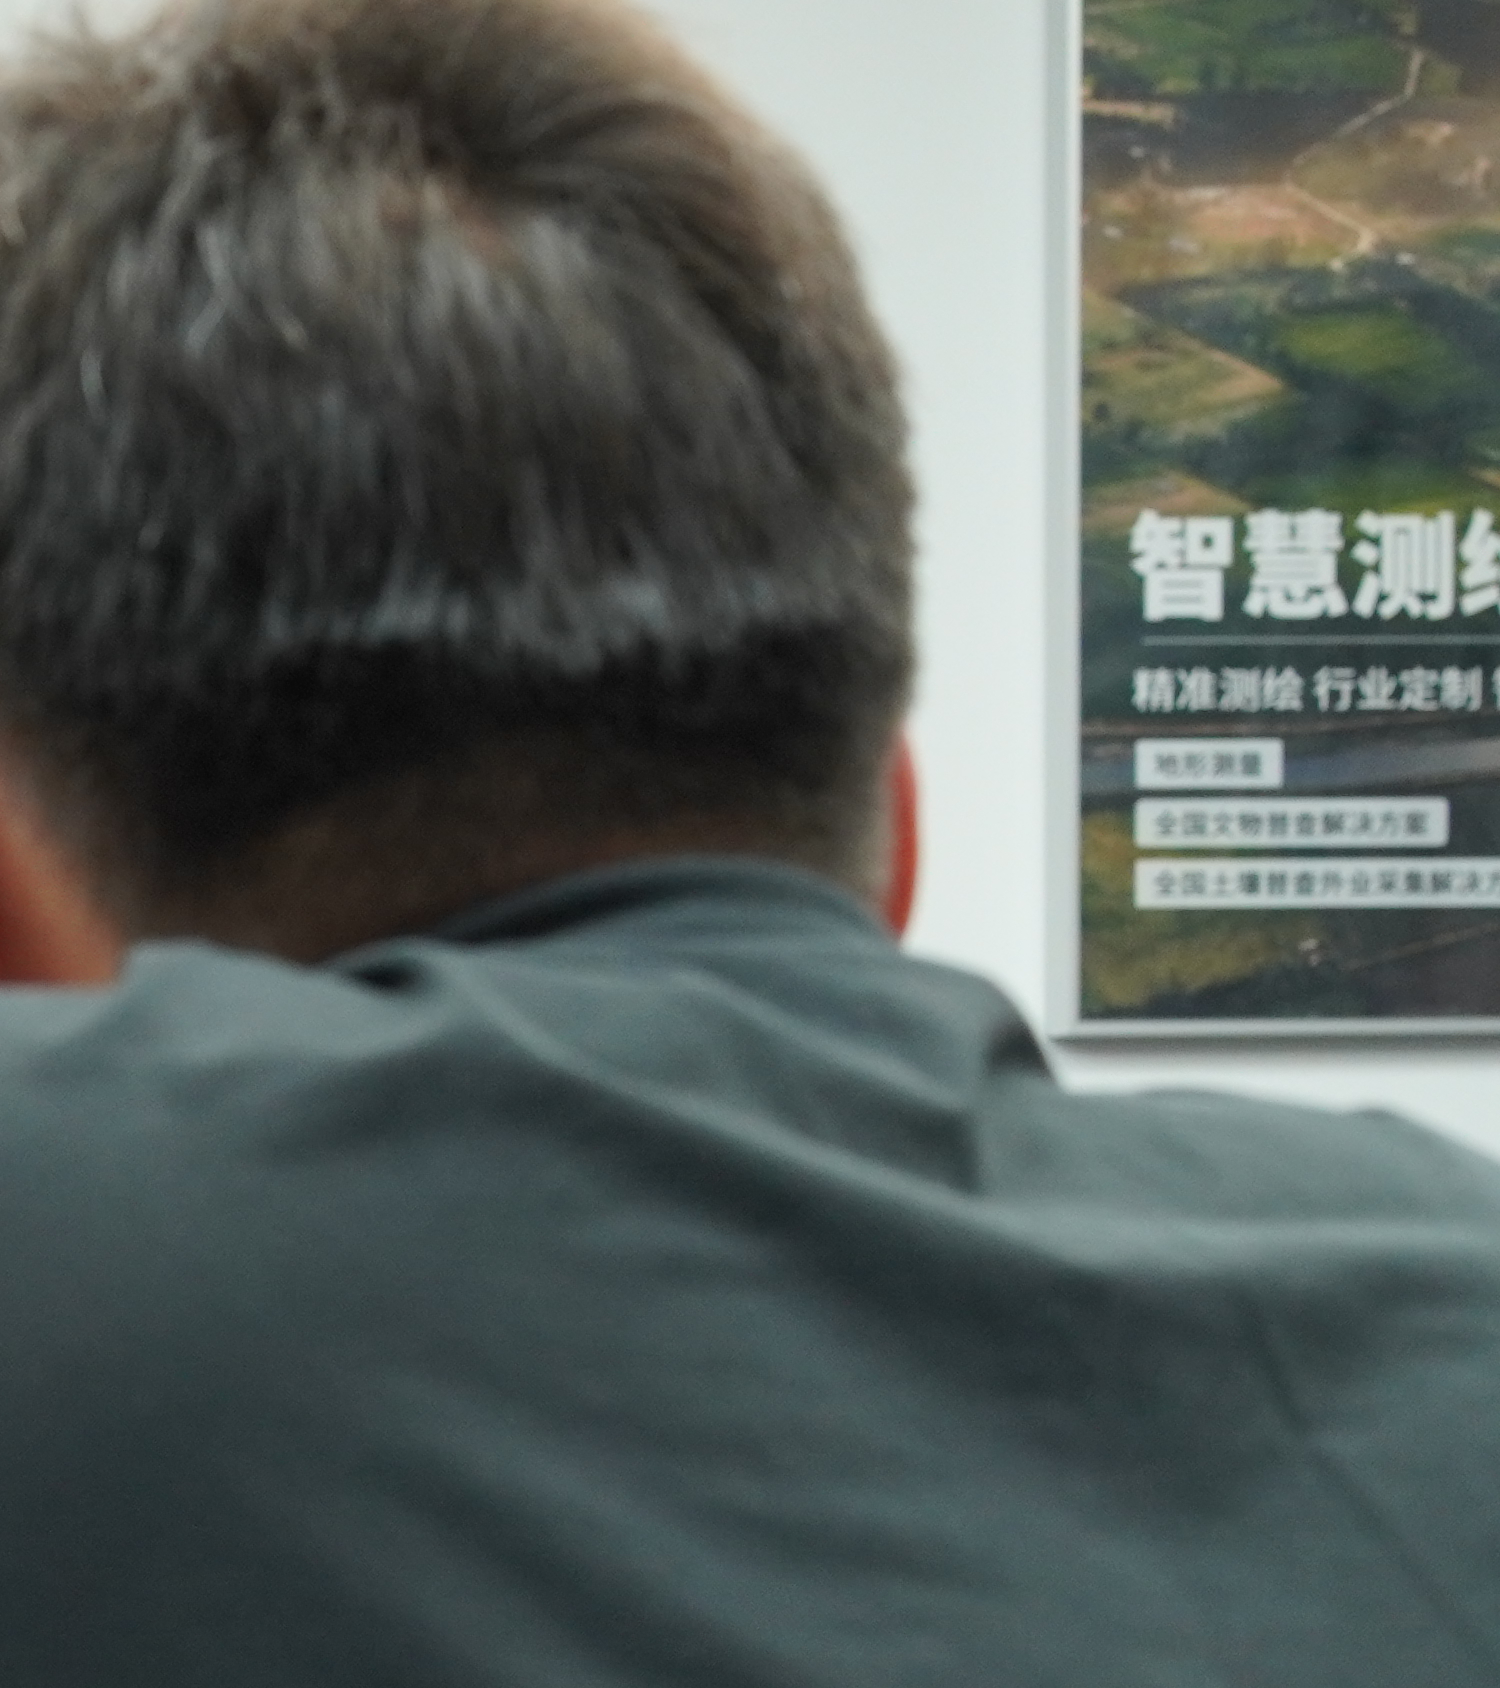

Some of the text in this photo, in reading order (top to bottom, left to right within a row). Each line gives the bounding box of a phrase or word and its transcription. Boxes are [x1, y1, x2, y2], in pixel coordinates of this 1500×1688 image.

[1131, 664, 1304, 713] 精准测绘
[1313, 664, 1483, 713] 行业定制
[1155, 751, 1263, 777] 地形测量
[1155, 810, 1428, 837] 全国文物普查解决方案
